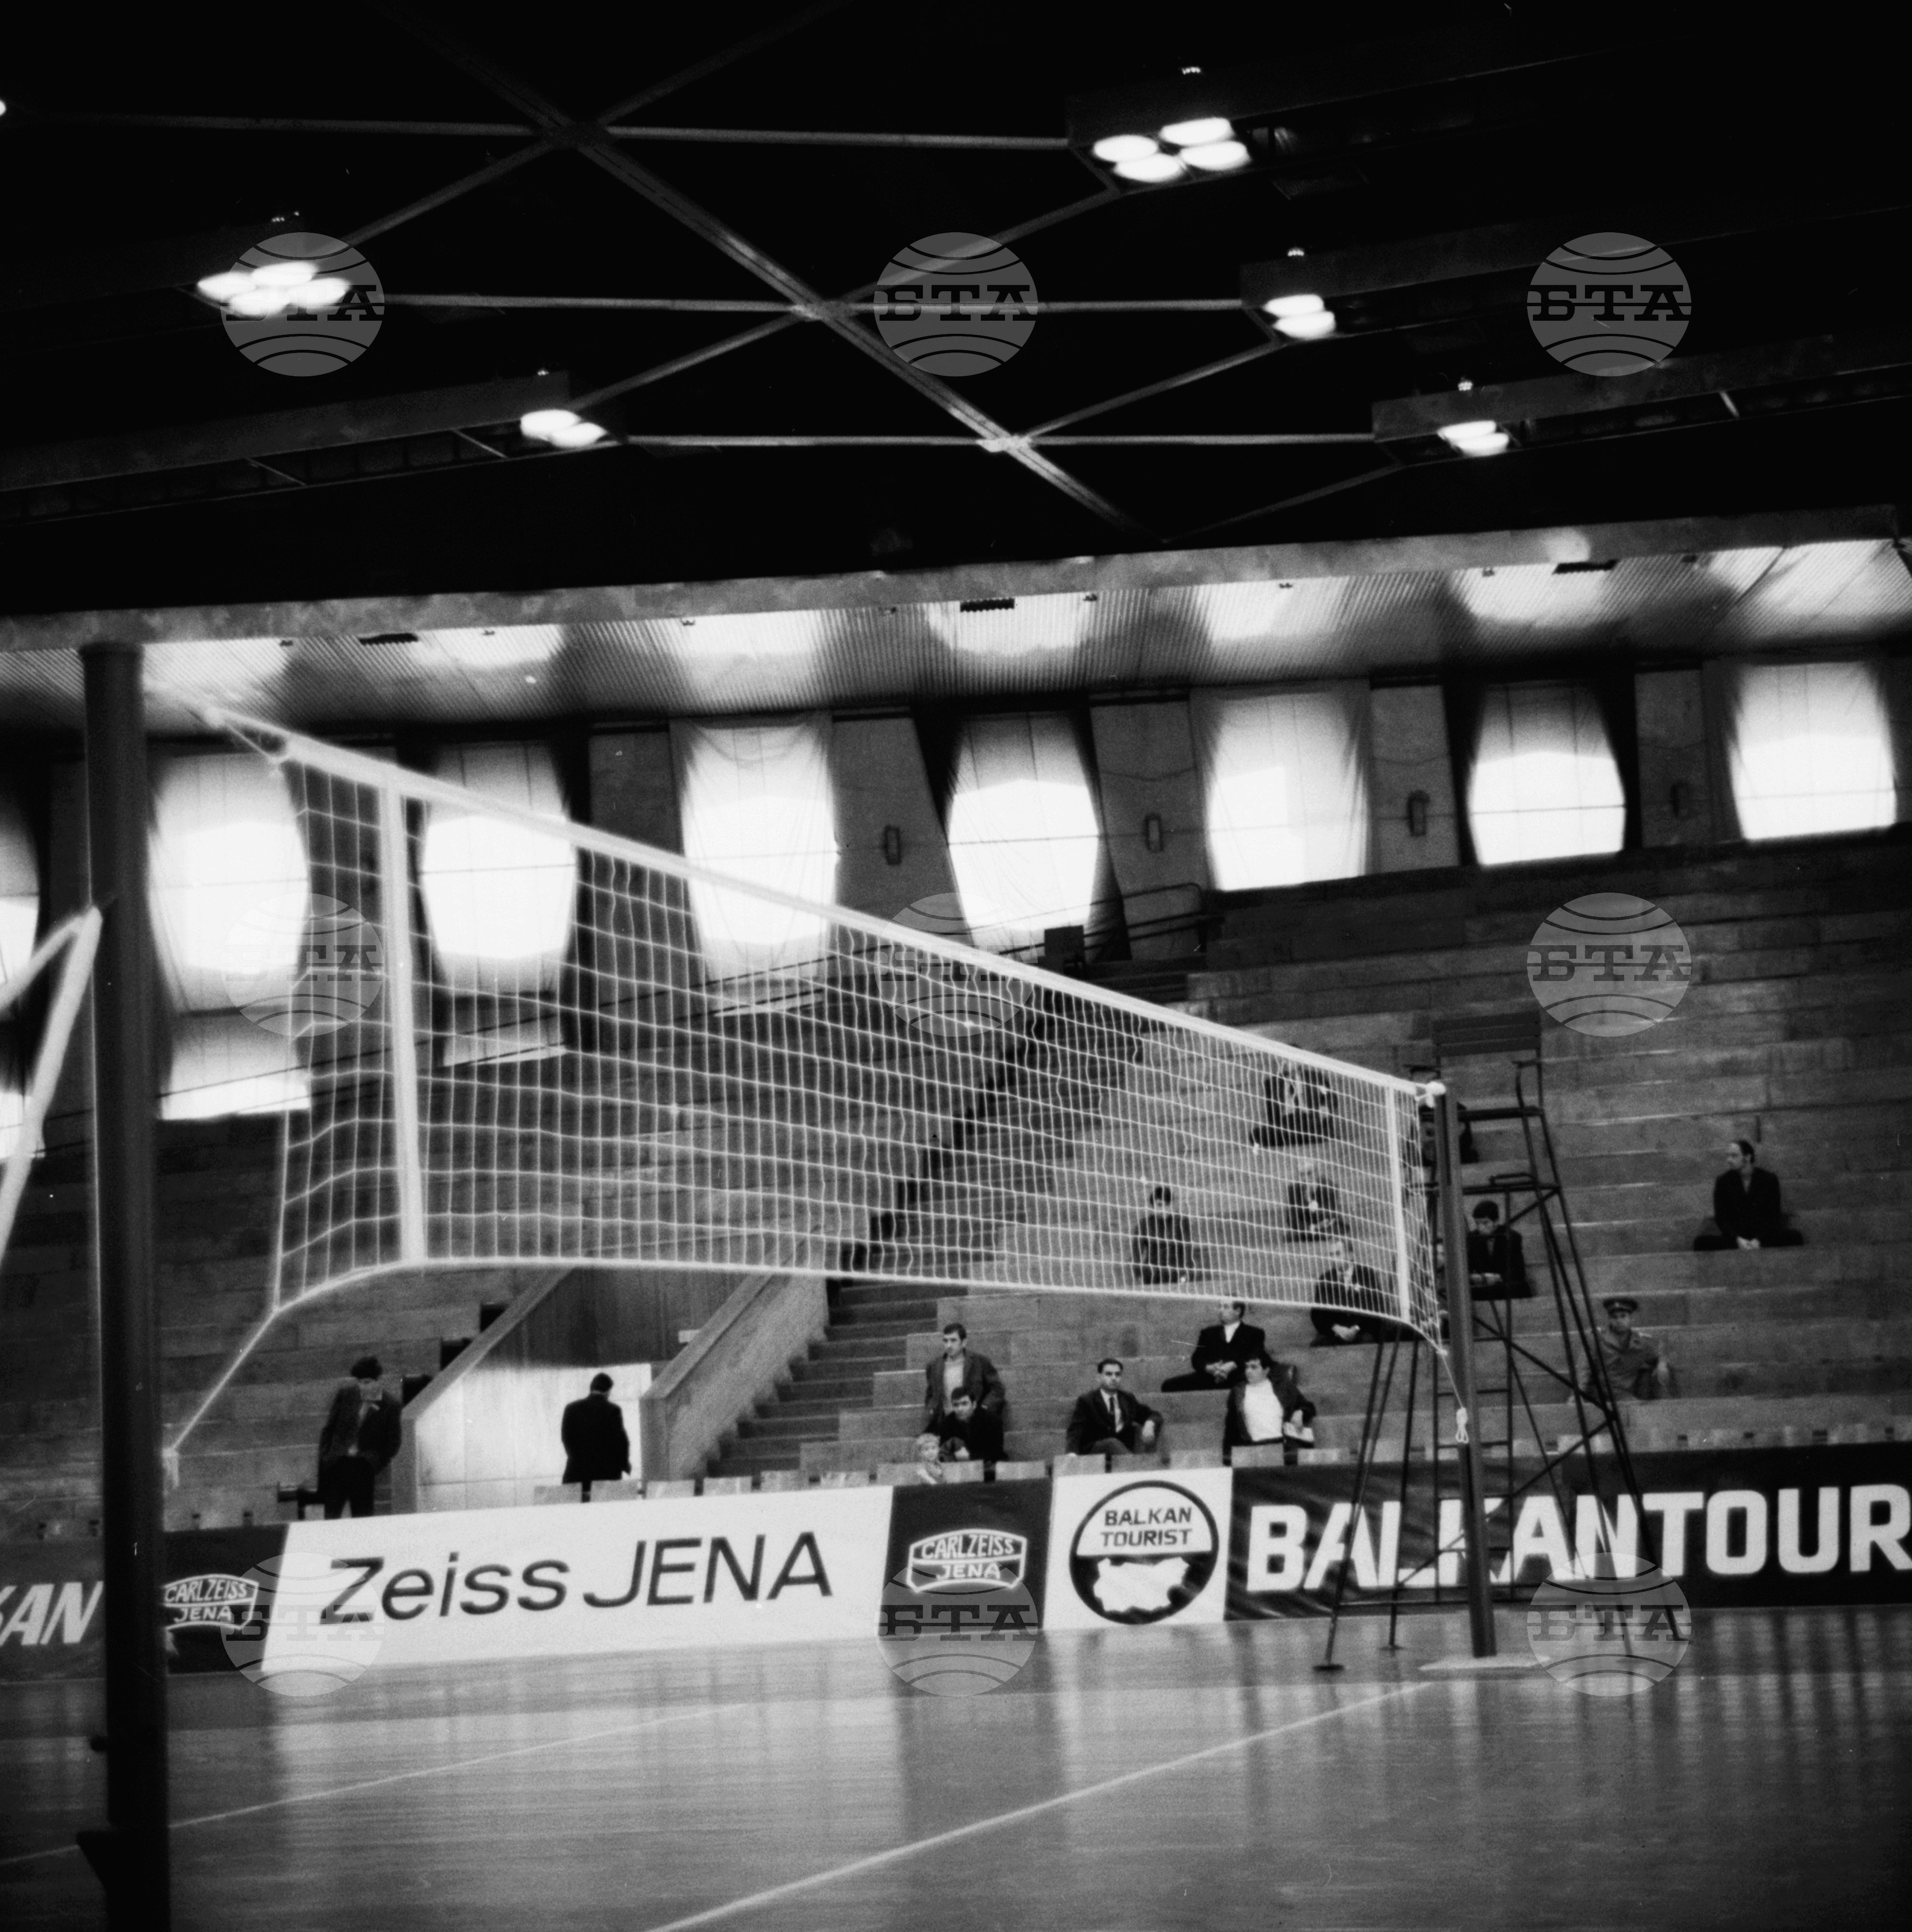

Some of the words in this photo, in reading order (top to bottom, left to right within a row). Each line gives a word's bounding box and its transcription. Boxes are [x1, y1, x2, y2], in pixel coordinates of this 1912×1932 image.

[1105, 1506, 1192, 1526] BALKAN
[1100, 1528, 1192, 1547] TOURIST
[319, 1551, 570, 1625] Zeiss
[582, 1531, 833, 1608] JENA
[936, 1563, 1001, 1580] JENA
[174, 1606, 232, 1623] JENA
